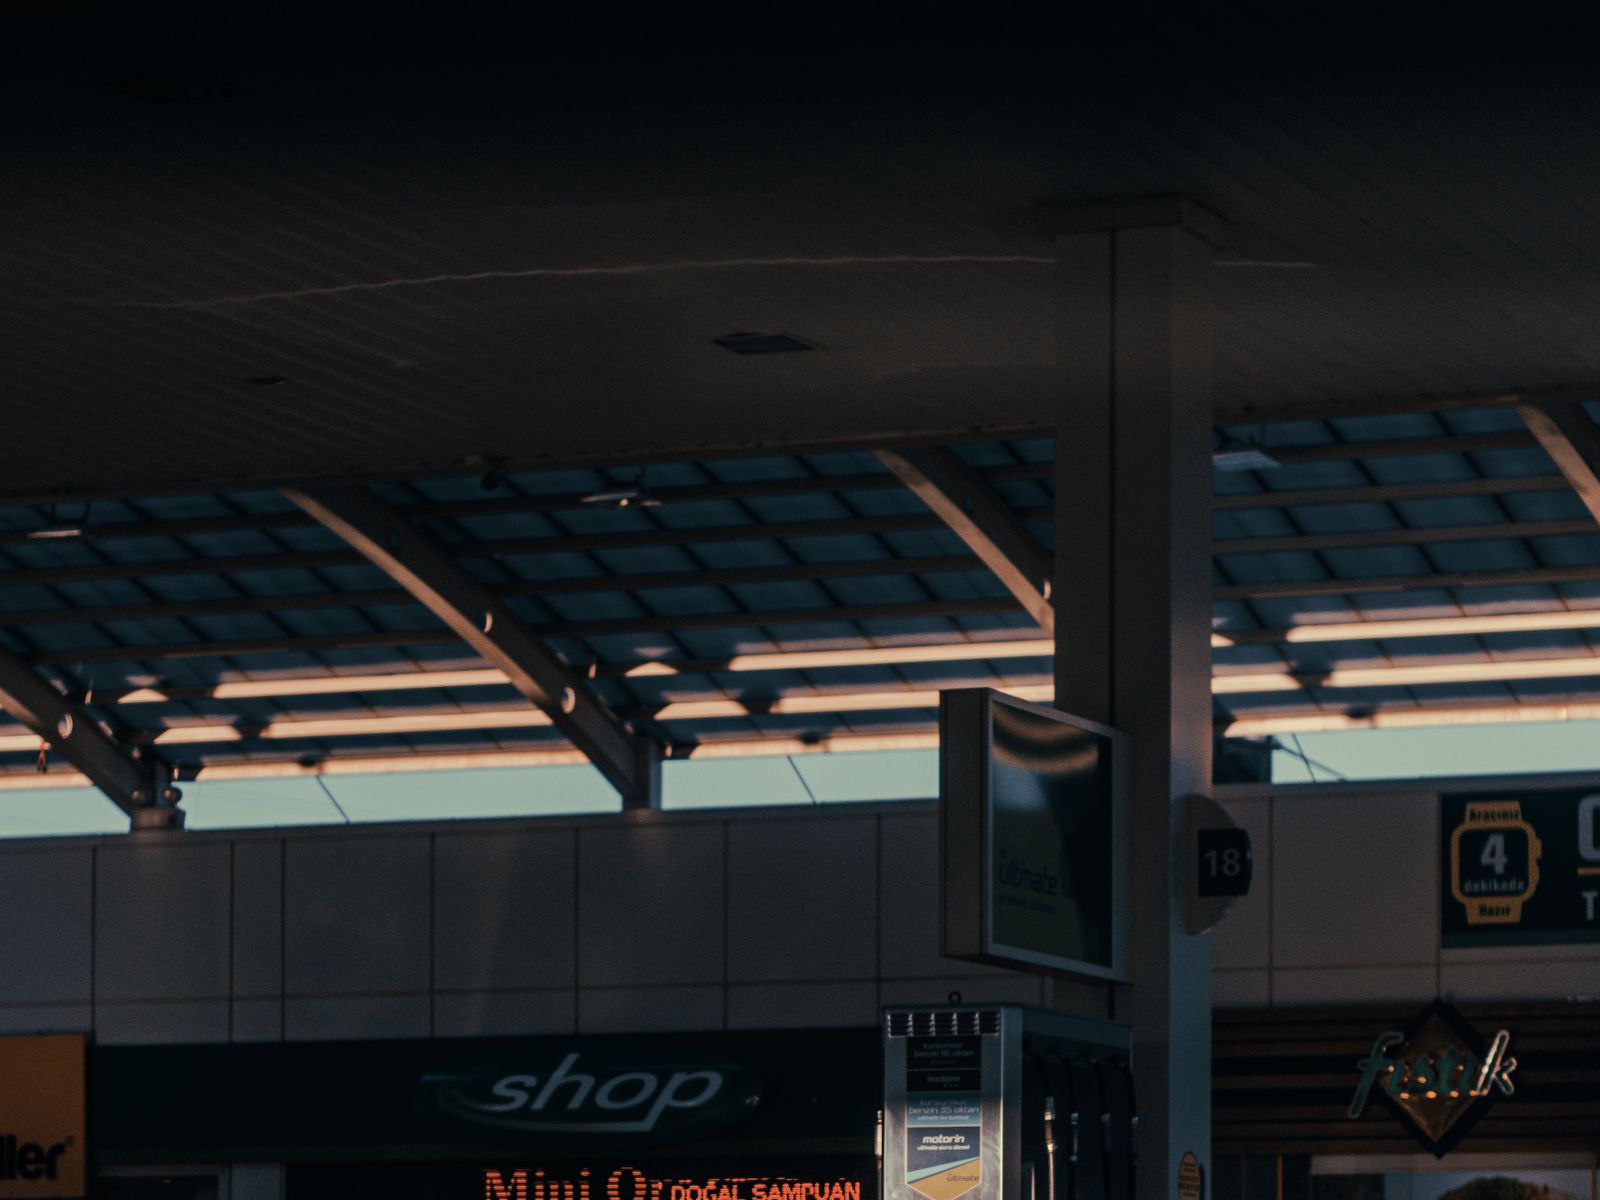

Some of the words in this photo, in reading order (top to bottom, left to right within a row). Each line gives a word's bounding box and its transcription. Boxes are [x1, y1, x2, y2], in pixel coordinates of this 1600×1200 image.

[1204, 848, 1241, 877] 18
[1480, 832, 1508, 875] 4
[926, 1073, 961, 1084] motorin
[491, 1052, 724, 1132] shop
[908, 1106, 938, 1115] benzin
[953, 1105, 979, 1114] oktan
[922, 1133, 965, 1144] motorin
